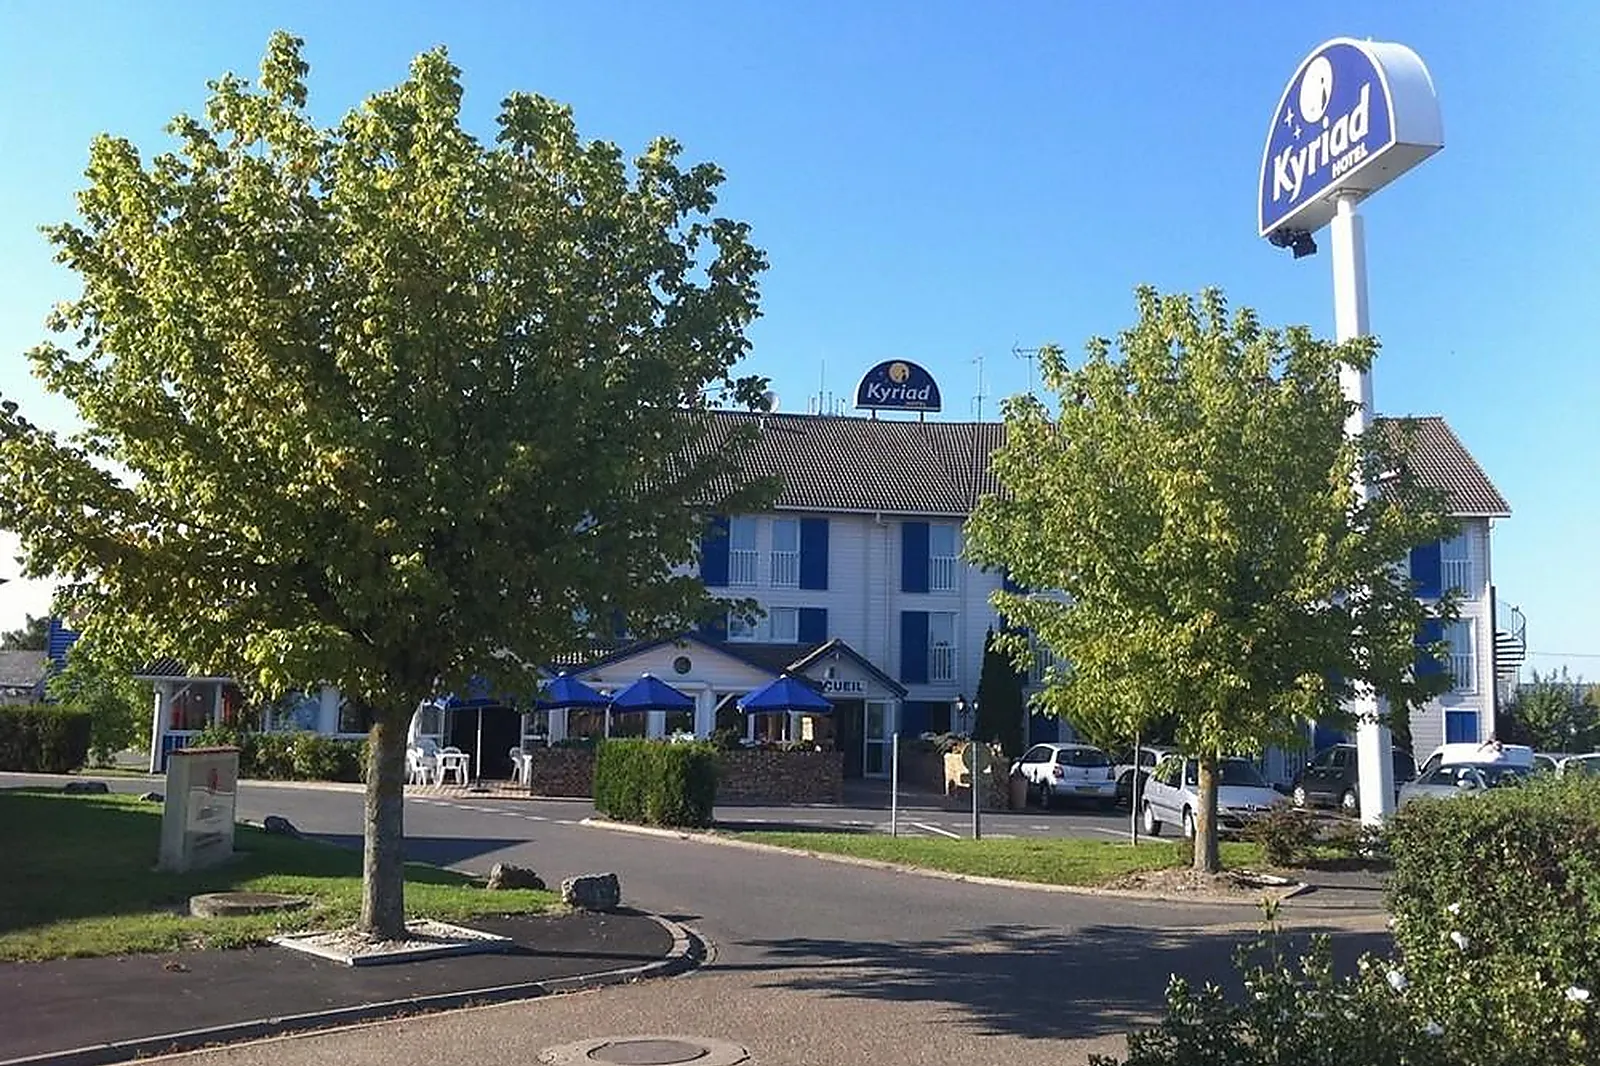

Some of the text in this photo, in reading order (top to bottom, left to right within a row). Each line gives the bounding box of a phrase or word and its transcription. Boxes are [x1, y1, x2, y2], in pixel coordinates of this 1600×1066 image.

[1273, 82, 1370, 203] Kyriad
[1332, 142, 1369, 179] HOTEL
[867, 383, 931, 403] Kyriad
[820, 680, 864, 692] CUEIL
